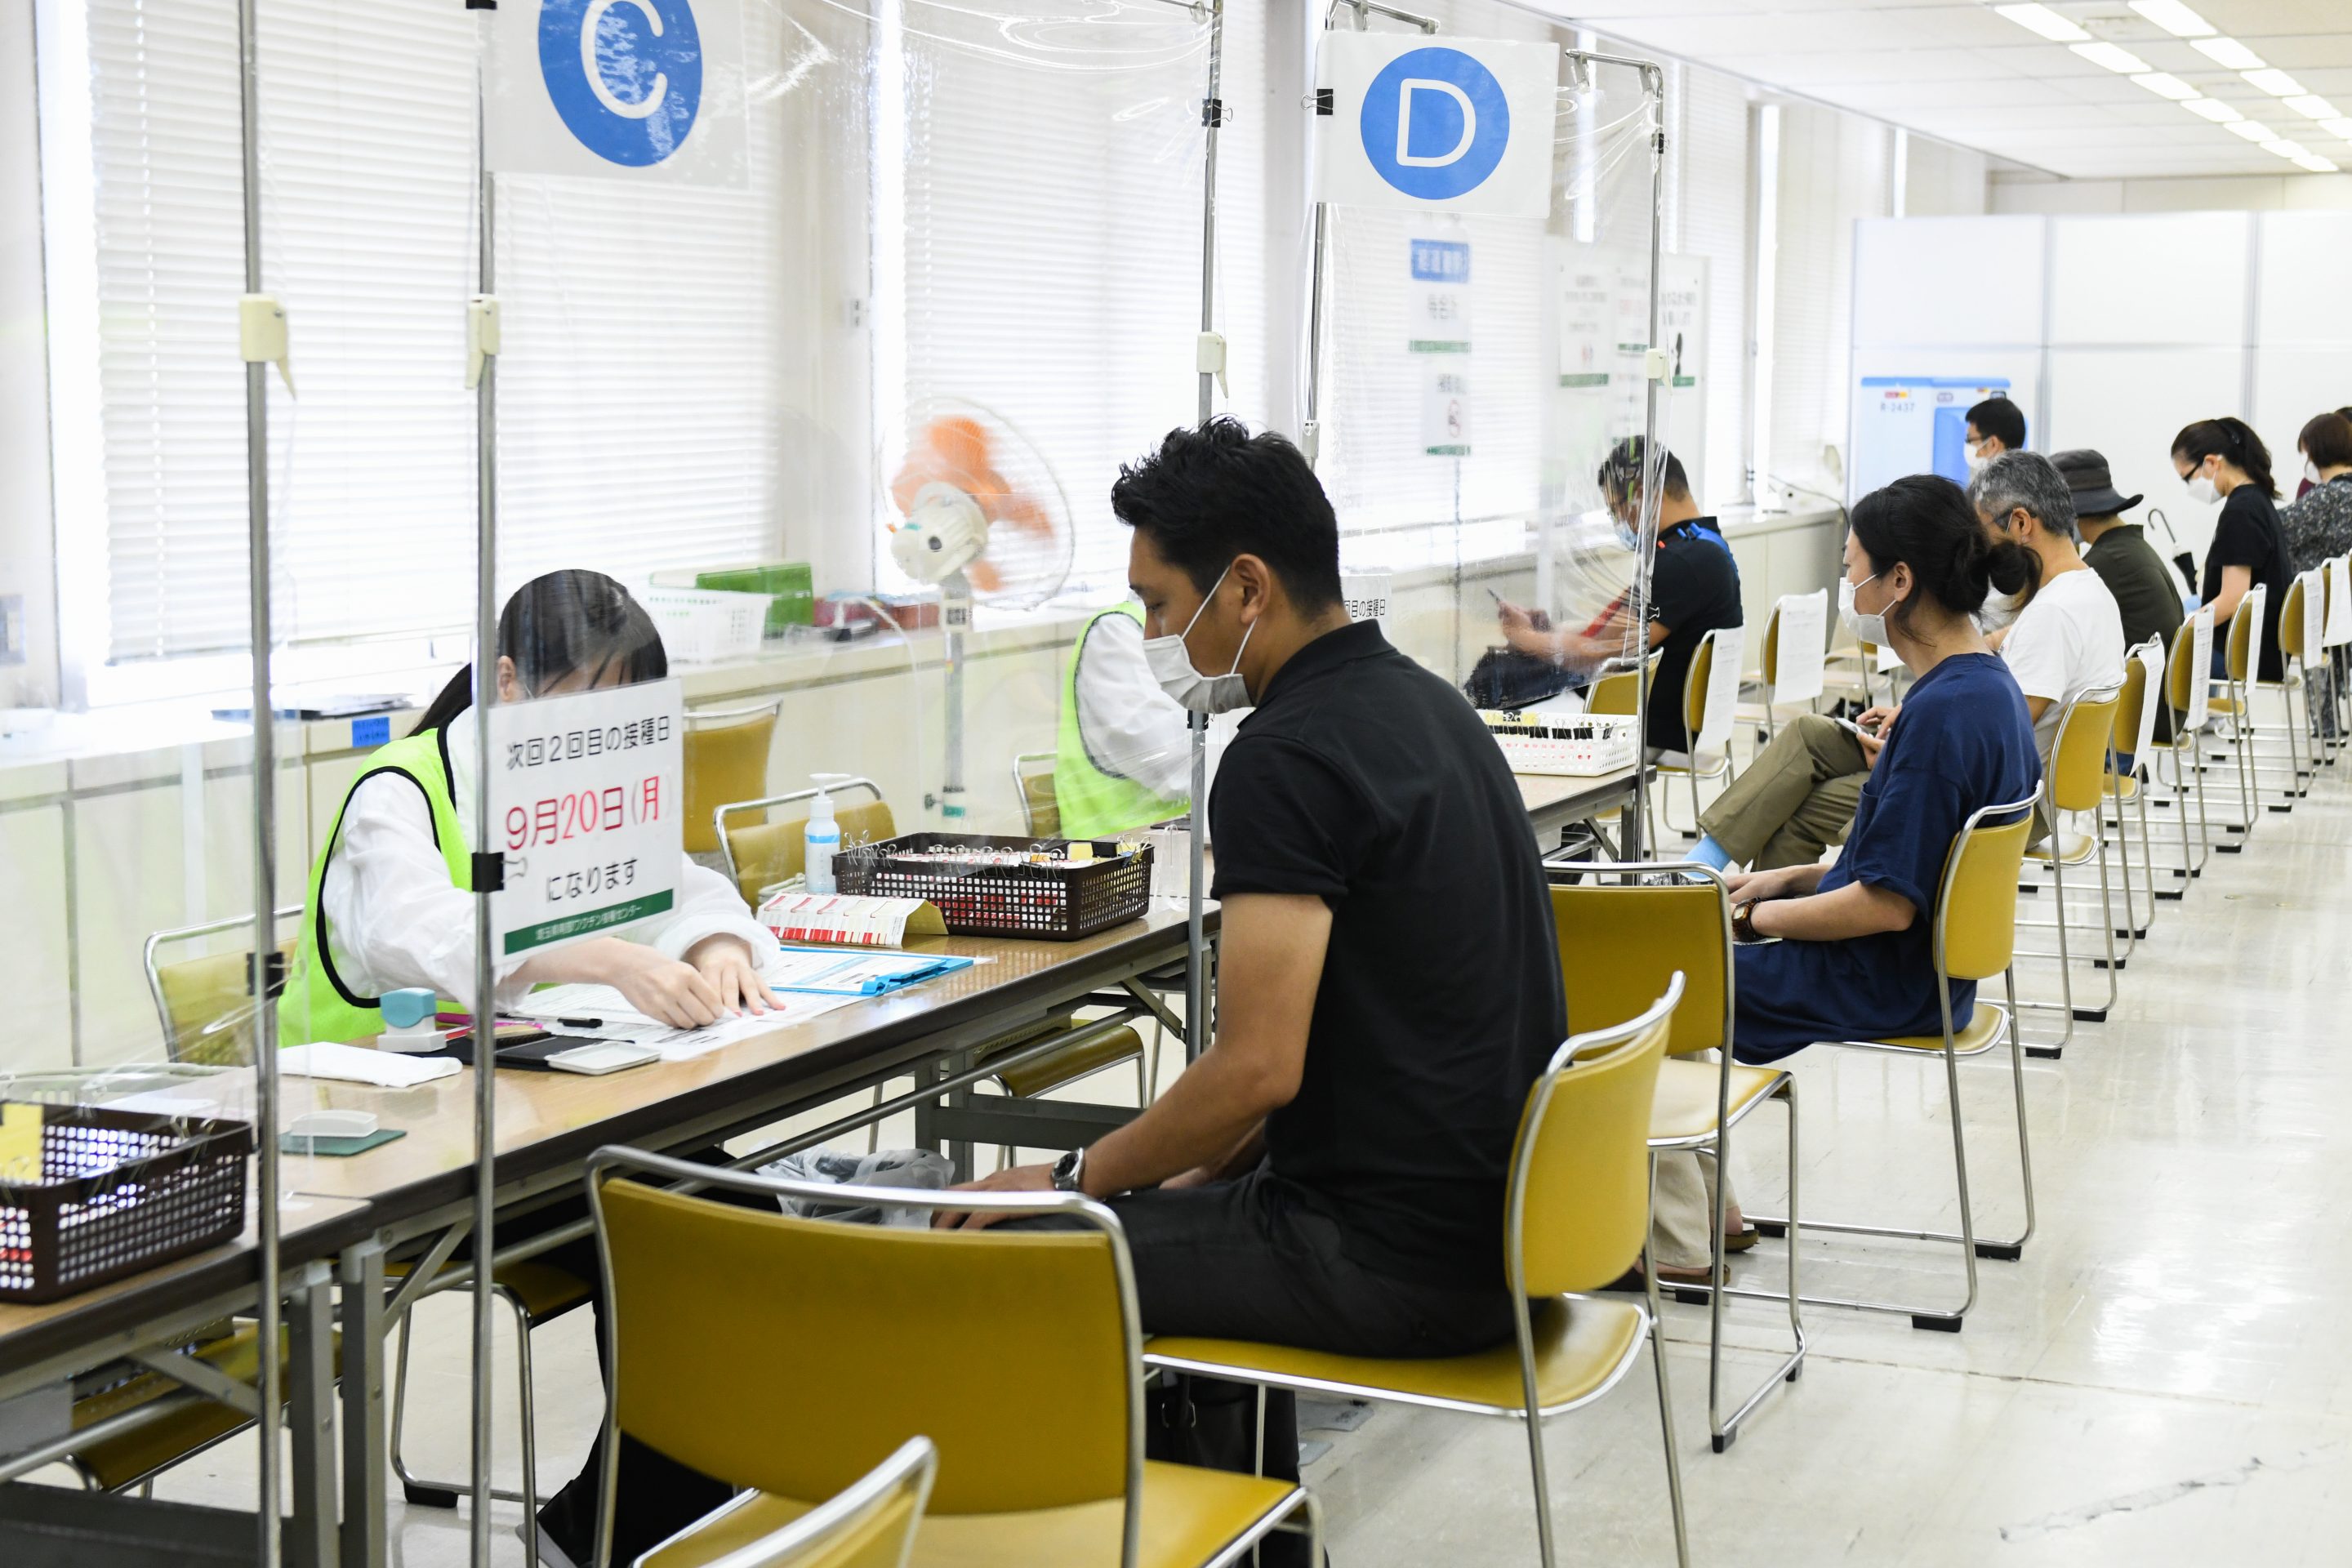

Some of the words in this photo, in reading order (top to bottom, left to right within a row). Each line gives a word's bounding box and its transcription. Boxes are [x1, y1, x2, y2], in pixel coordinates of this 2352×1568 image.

[581, 0, 667, 120] C
[1396, 78, 1477, 167] D
[506, 715, 670, 770] 次回2回目の接種日
[546, 858, 638, 902] になります
